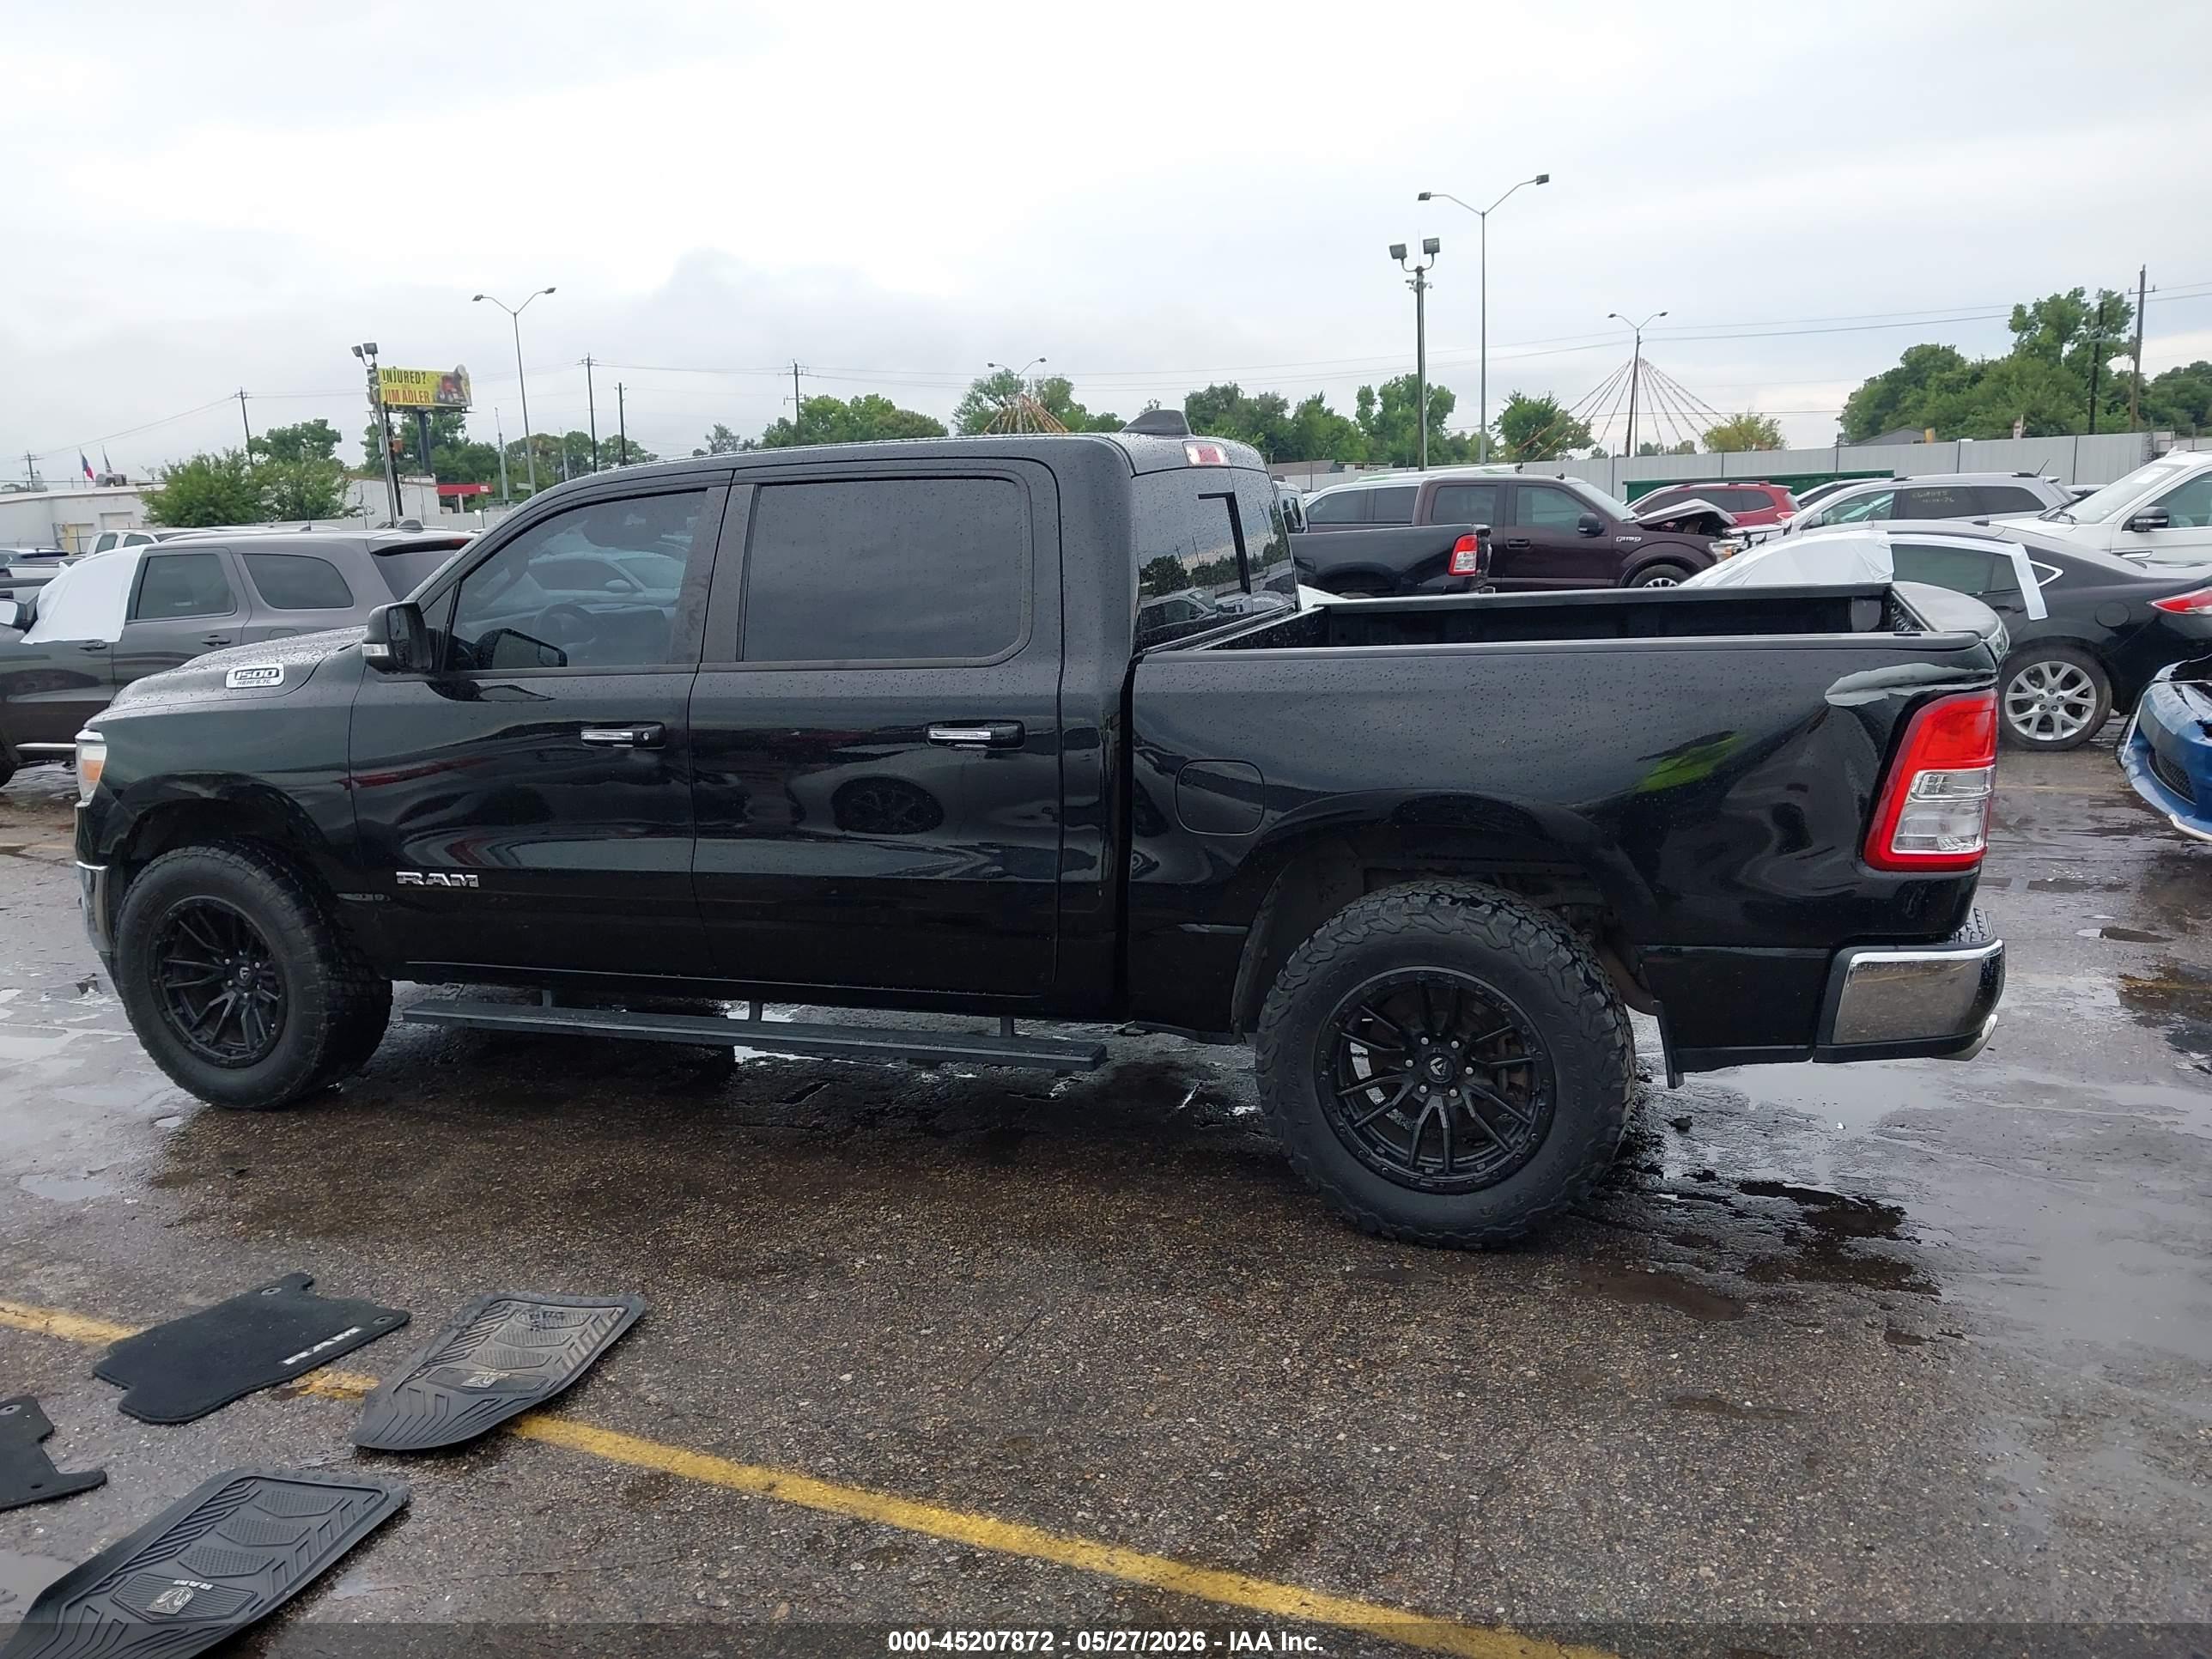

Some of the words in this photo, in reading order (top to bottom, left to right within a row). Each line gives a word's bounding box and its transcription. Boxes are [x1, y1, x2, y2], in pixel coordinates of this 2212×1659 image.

[382, 370, 426, 385] INJURED?
[402, 390, 430, 404] ADLER
[235, 669, 277, 680] 1500
[395, 871, 480, 888] RAM
[282, 1327, 362, 1365] RAM
[173, 1579, 214, 1590] RAM
